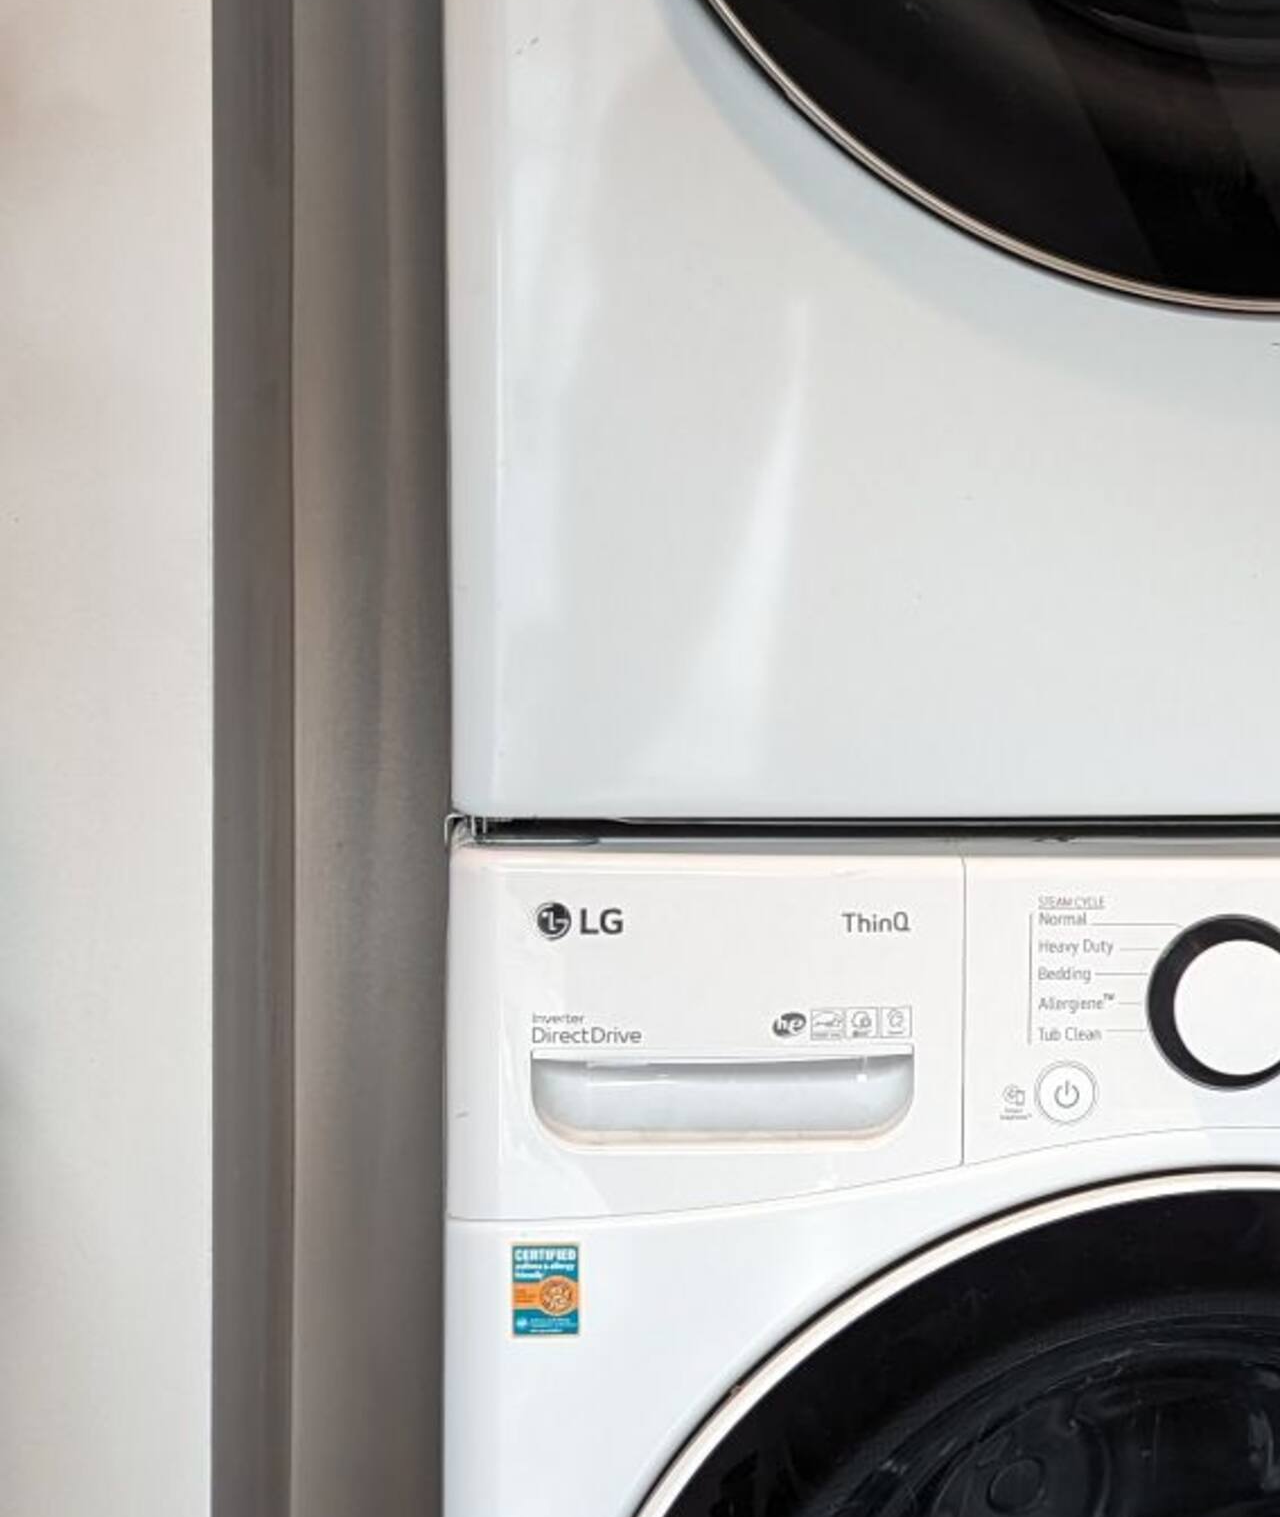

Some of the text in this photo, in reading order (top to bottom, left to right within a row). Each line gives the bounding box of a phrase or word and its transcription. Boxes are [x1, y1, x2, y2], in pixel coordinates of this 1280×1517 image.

[1038, 896, 1105, 909] STEAM CYCLE
[580, 908, 624, 935] LG
[842, 911, 911, 934] ThinQ
[1039, 912, 1088, 927] Normal
[1038, 938, 1114, 956] Heavy Duty
[1038, 967, 1092, 984] Bedding
[532, 1012, 585, 1025] Inverter
[1038, 1027, 1103, 1041] Tub Clean
[514, 1248, 577, 1261] CERTIFIED
